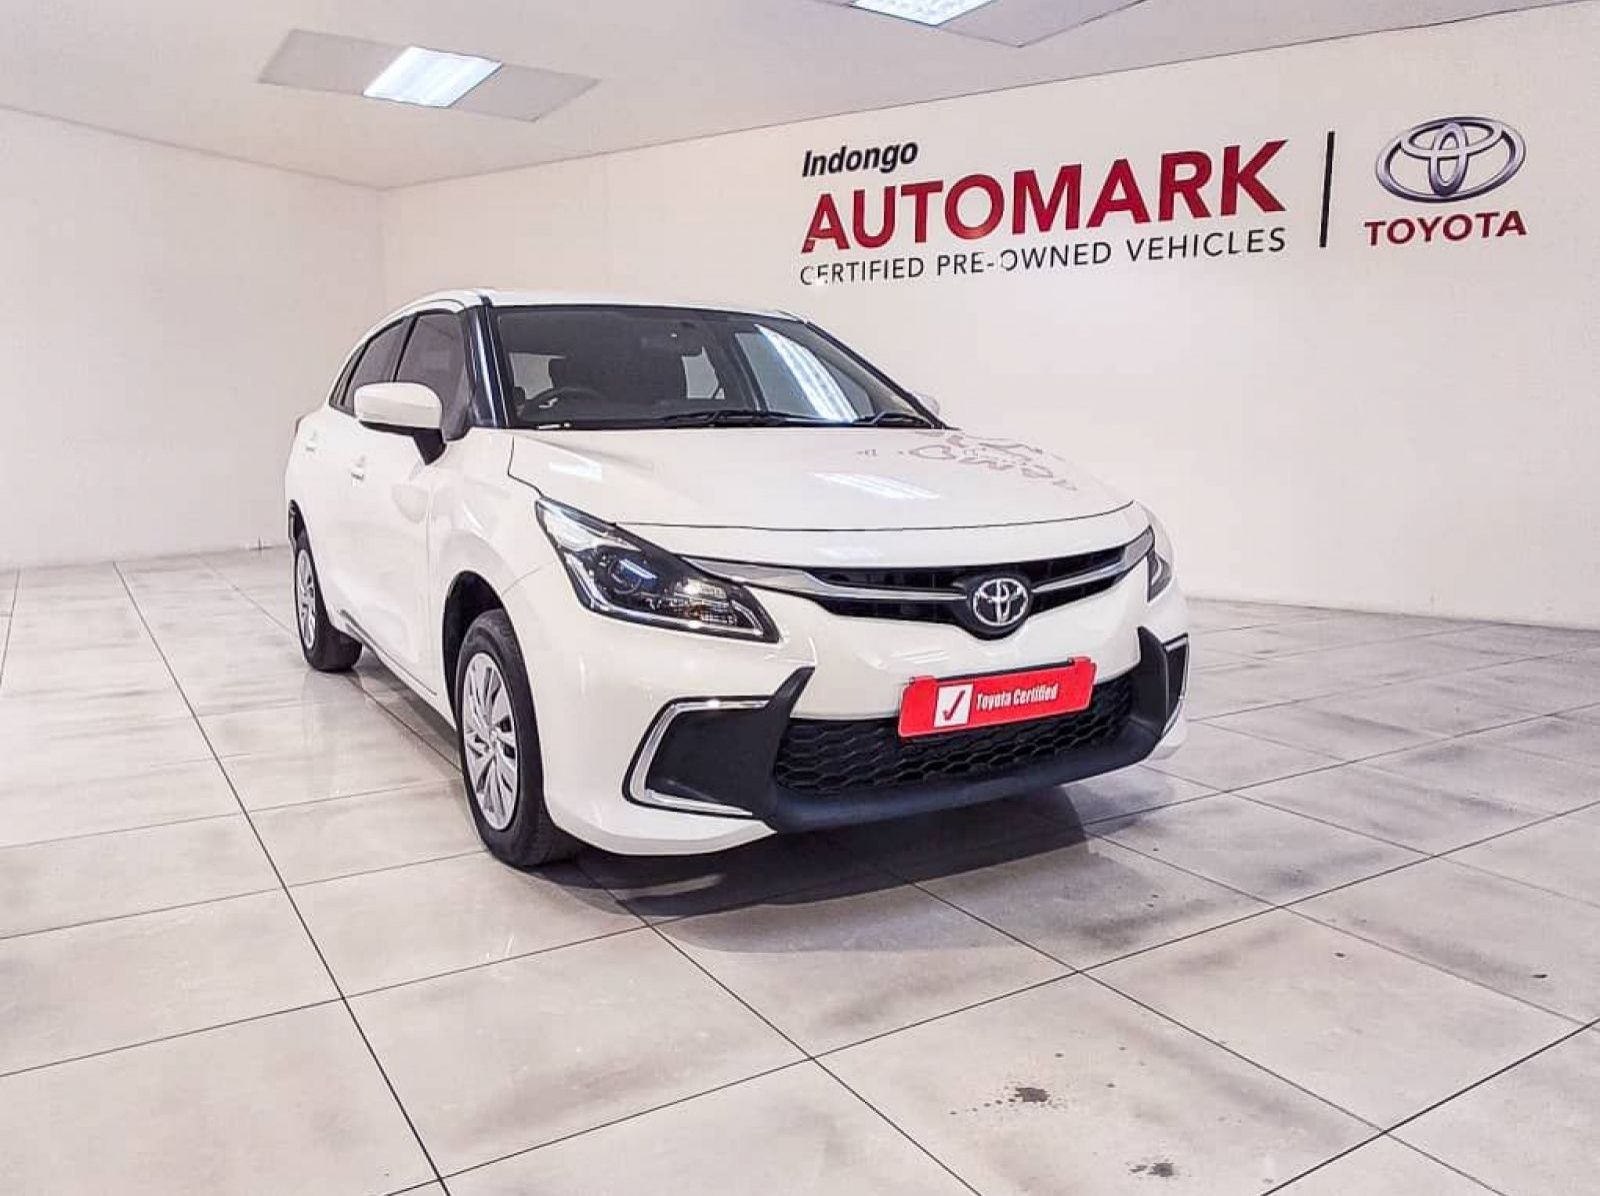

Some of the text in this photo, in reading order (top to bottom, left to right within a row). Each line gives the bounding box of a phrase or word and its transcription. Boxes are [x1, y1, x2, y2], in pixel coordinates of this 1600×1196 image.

[802, 140, 919, 177] Indongo
[800, 138, 1288, 254] AUTOMARK
[1364, 210, 1527, 247] TOYOTA
[800, 226, 1286, 286] CERTIFIED PRE-OWNED VEHICLES
[976, 683, 1059, 711] Toyota Certified
